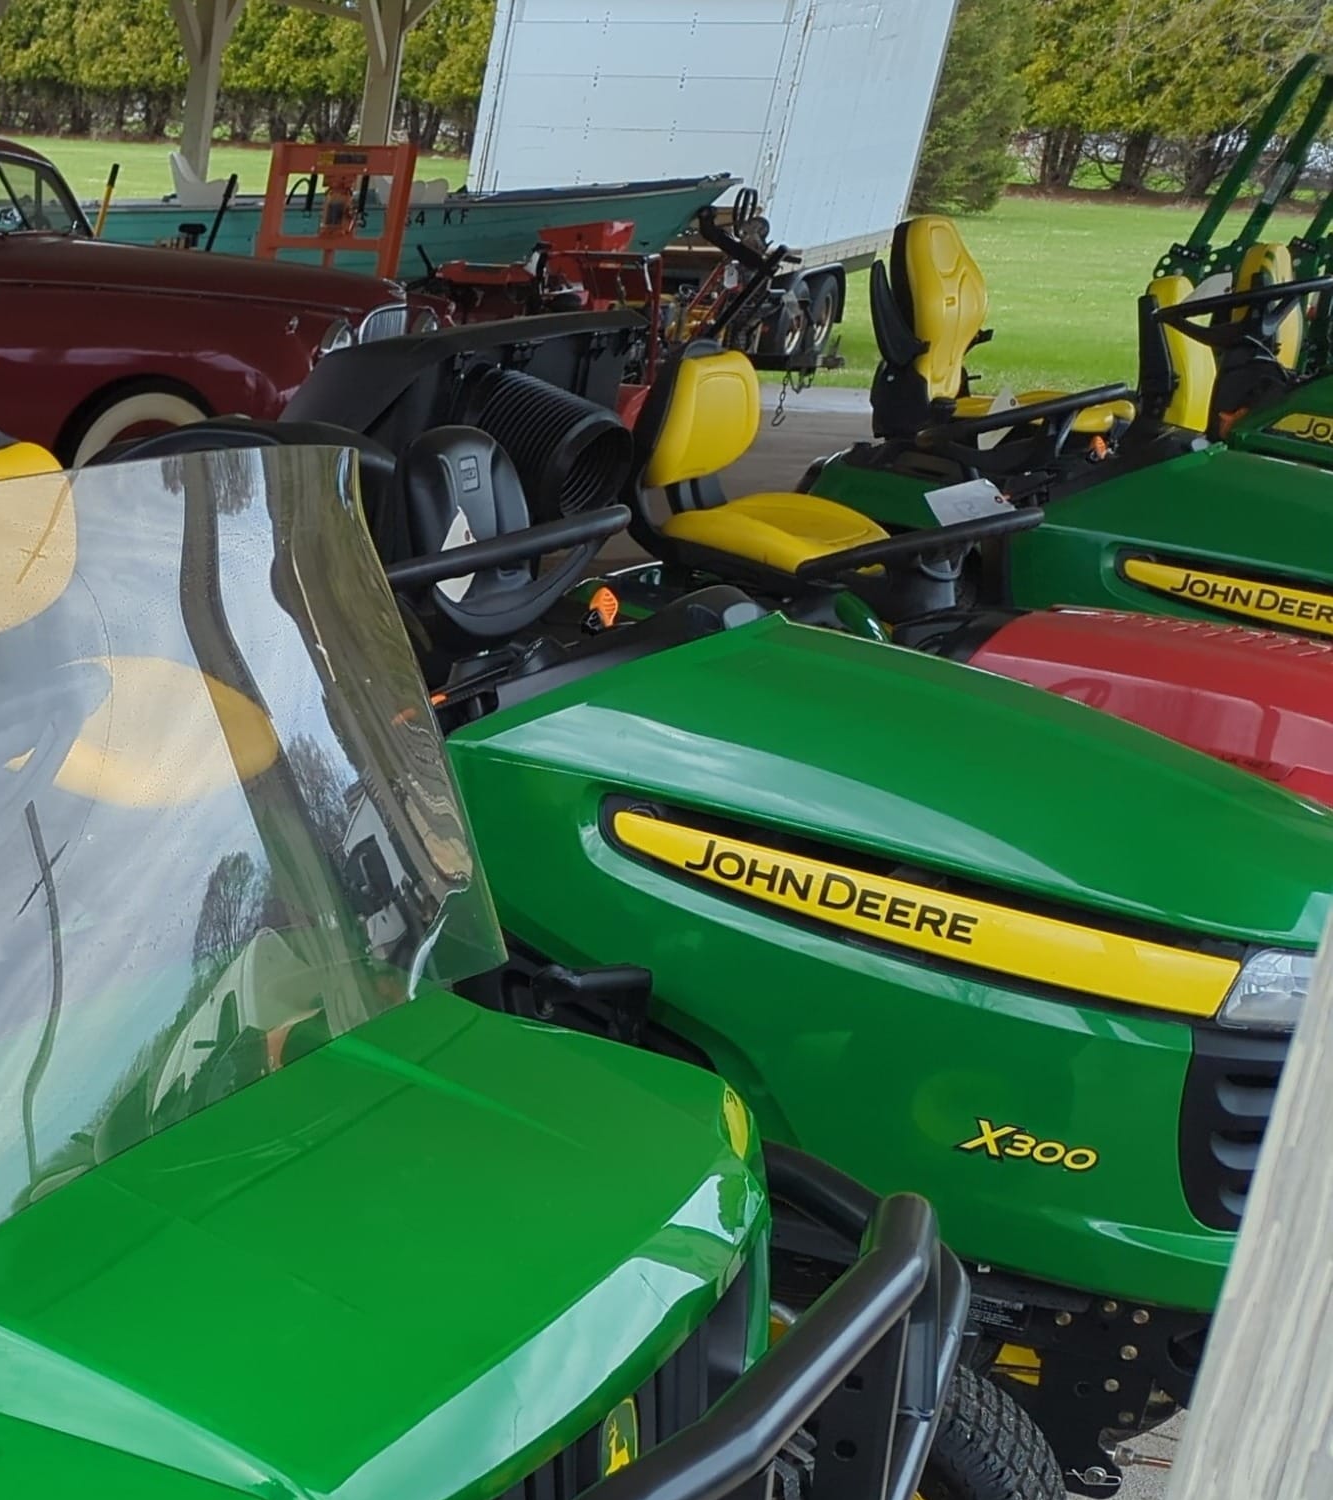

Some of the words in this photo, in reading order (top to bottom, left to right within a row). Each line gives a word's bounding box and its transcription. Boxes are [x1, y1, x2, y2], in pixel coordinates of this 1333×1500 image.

[1296, 417, 1333, 440] JO
[1170, 572, 1254, 608] JOHN
[684, 840, 814, 902] JOHN
[817, 872, 979, 945] DEERE
[955, 1117, 1099, 1172] X300
